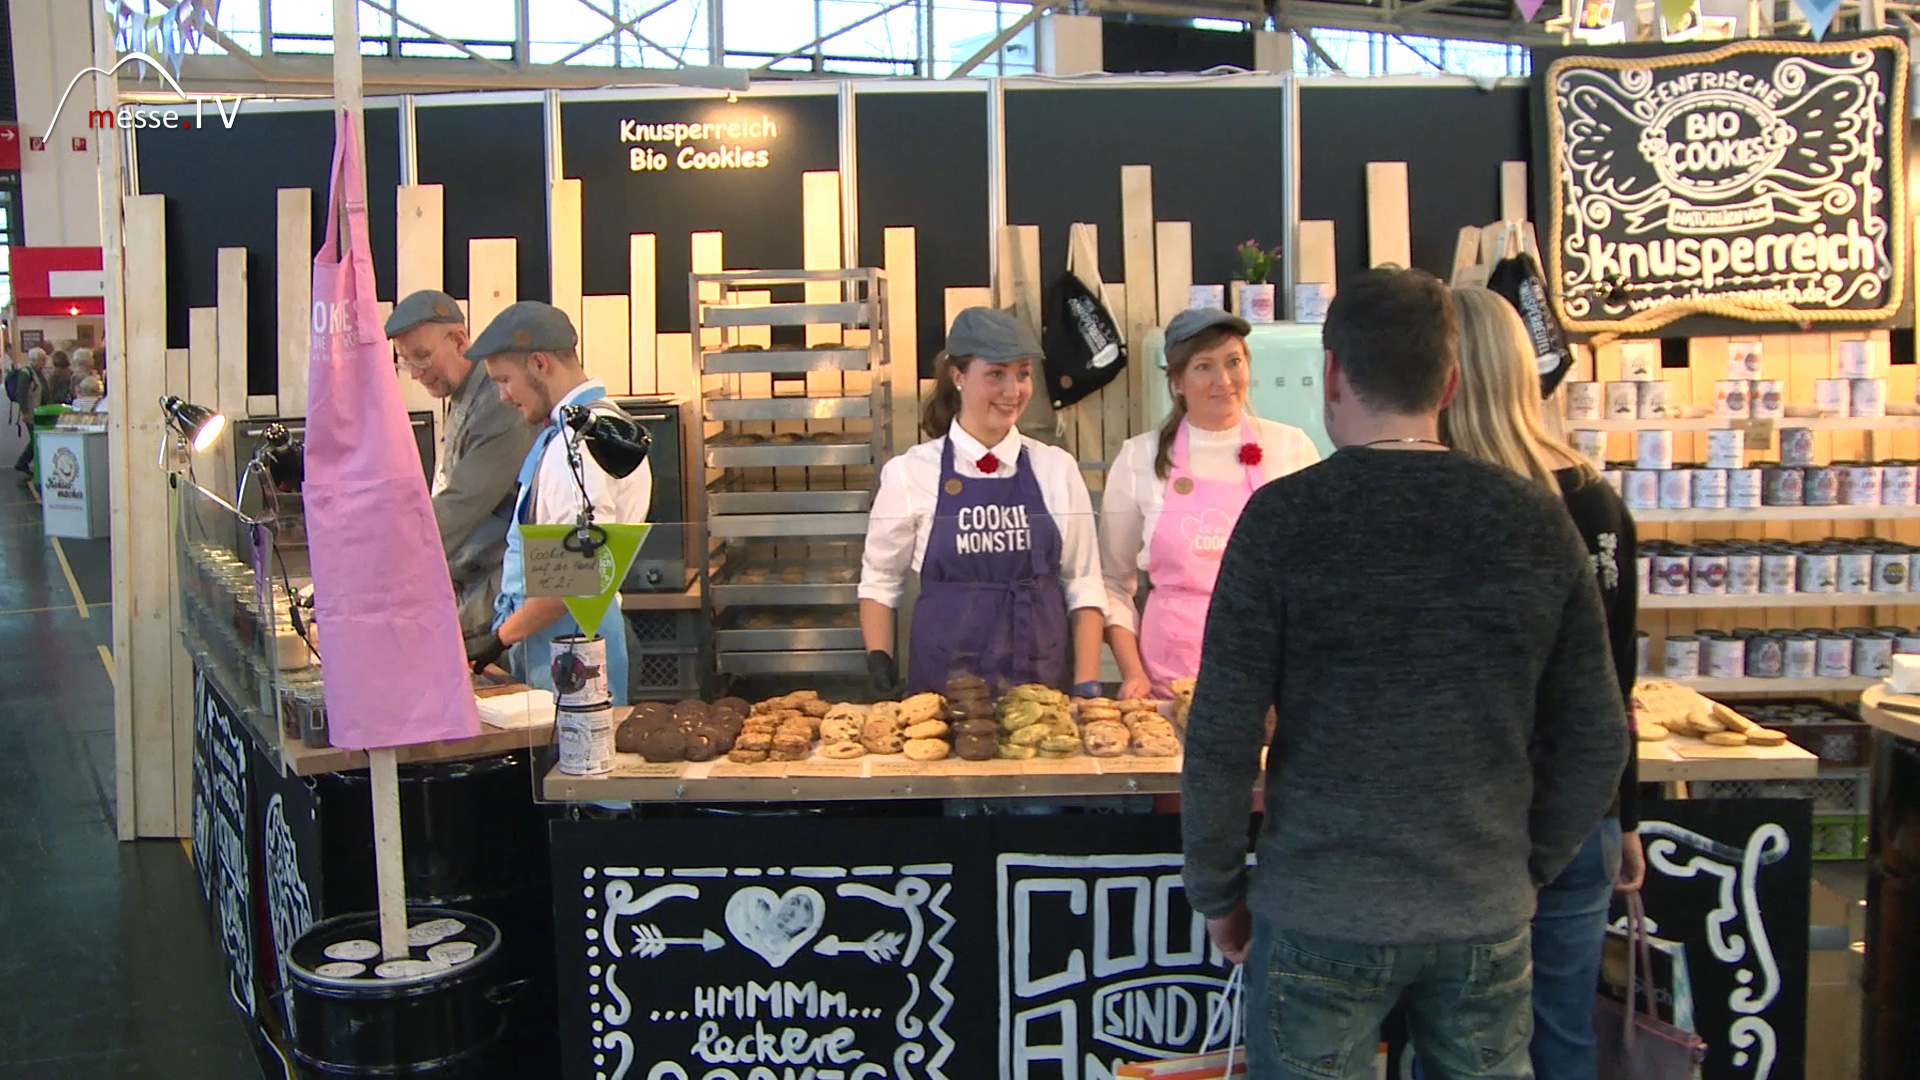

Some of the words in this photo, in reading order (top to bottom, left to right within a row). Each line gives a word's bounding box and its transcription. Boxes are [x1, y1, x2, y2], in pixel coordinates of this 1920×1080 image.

[1632, 70, 1784, 119] OFENFRISCHE
[620, 114, 778, 148] Knusperreich
[1685, 111, 1741, 142] BIO
[629, 147, 669, 171] Bio
[676, 144, 770, 170] Cookies
[1667, 137, 1767, 172] COOKIES
[1588, 217, 1877, 290] knusperreich
[958, 504, 1030, 531] COOKIE
[1104, 985, 1198, 1047] SIND
[690, 1019, 865, 1065] leckere
